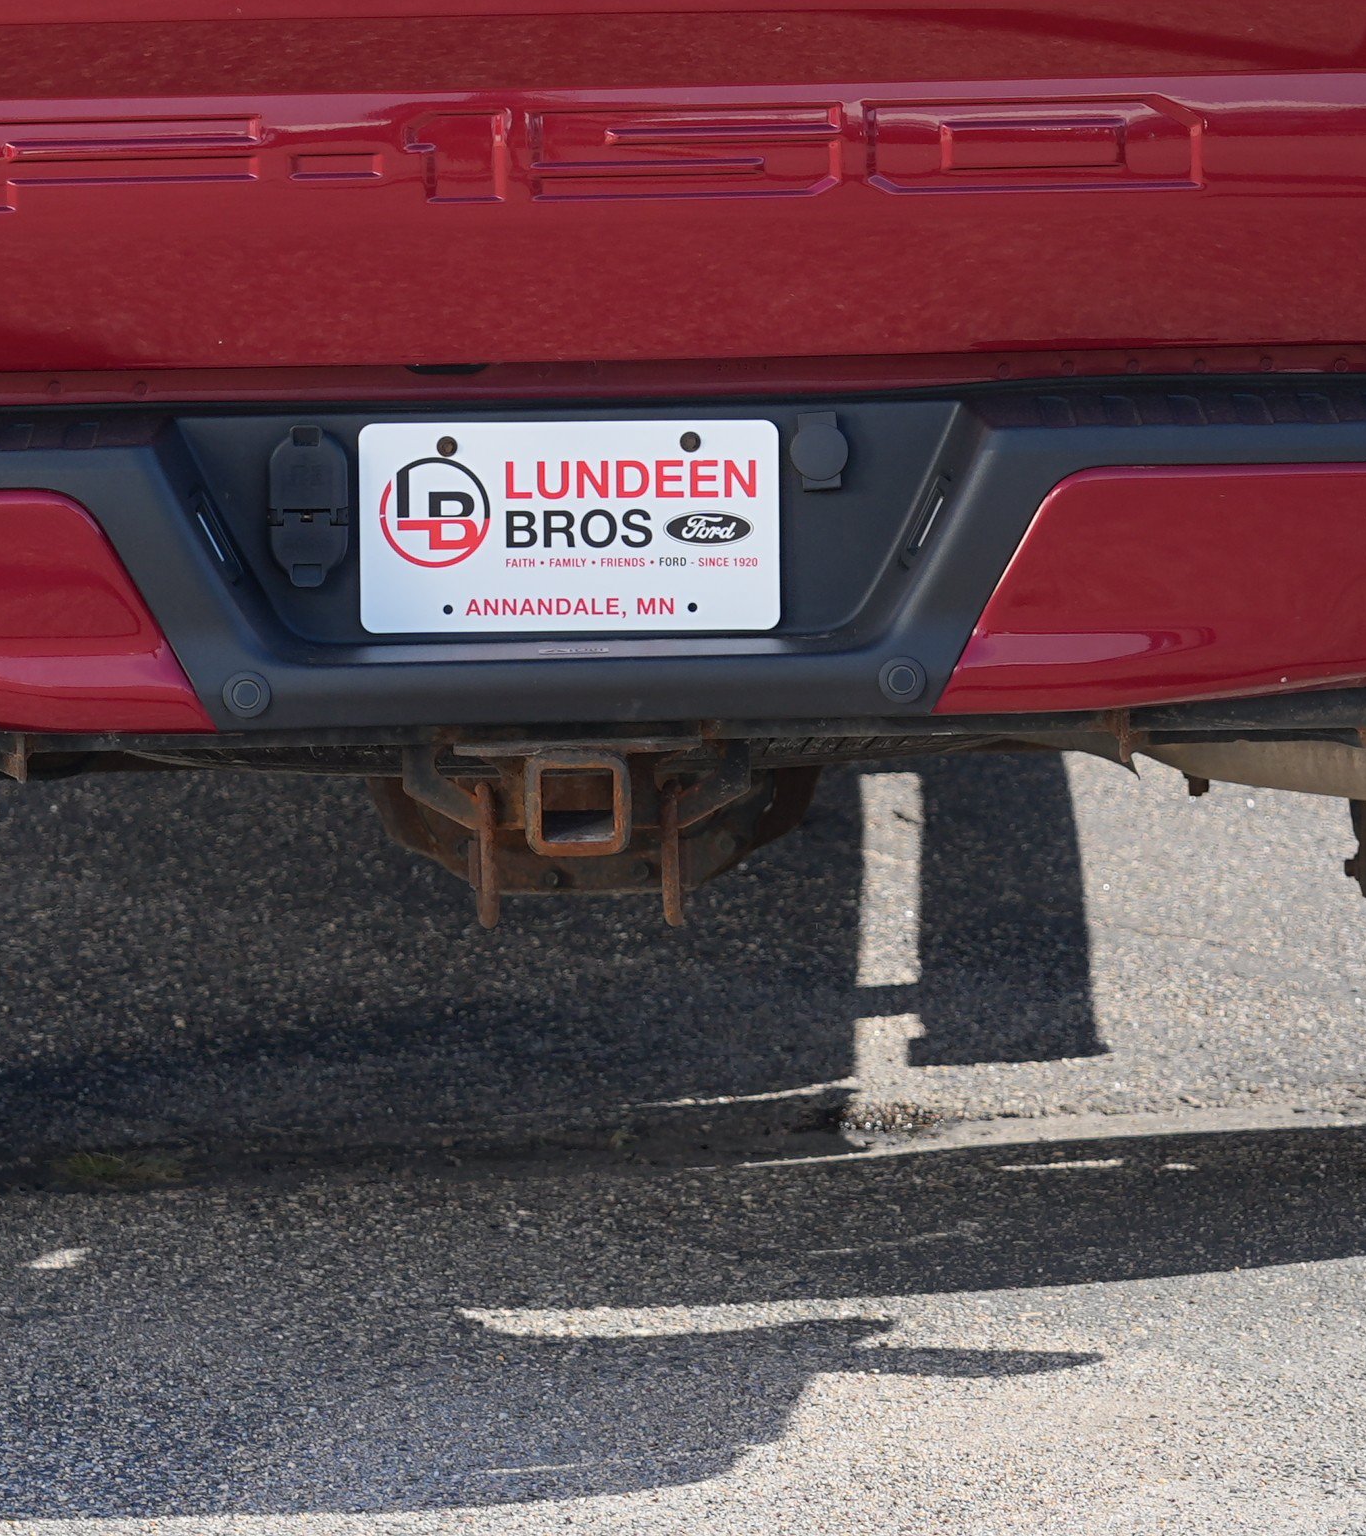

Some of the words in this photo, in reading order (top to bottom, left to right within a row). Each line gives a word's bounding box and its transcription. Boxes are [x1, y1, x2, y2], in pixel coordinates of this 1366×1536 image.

[505, 460, 756, 499] LUNDEEN
[505, 509, 653, 549] BROS
[681, 515, 736, 540] Ford
[505, 558, 536, 568] FAITH
[549, 557, 587, 568] FAMILY
[600, 557, 646, 568] FRIENDS
[659, 557, 687, 567] FORD
[698, 557, 729, 567] SINCE
[733, 557, 759, 567] 1920
[465, 597, 628, 619] ANNANDALE,
[636, 598, 675, 616] MN
